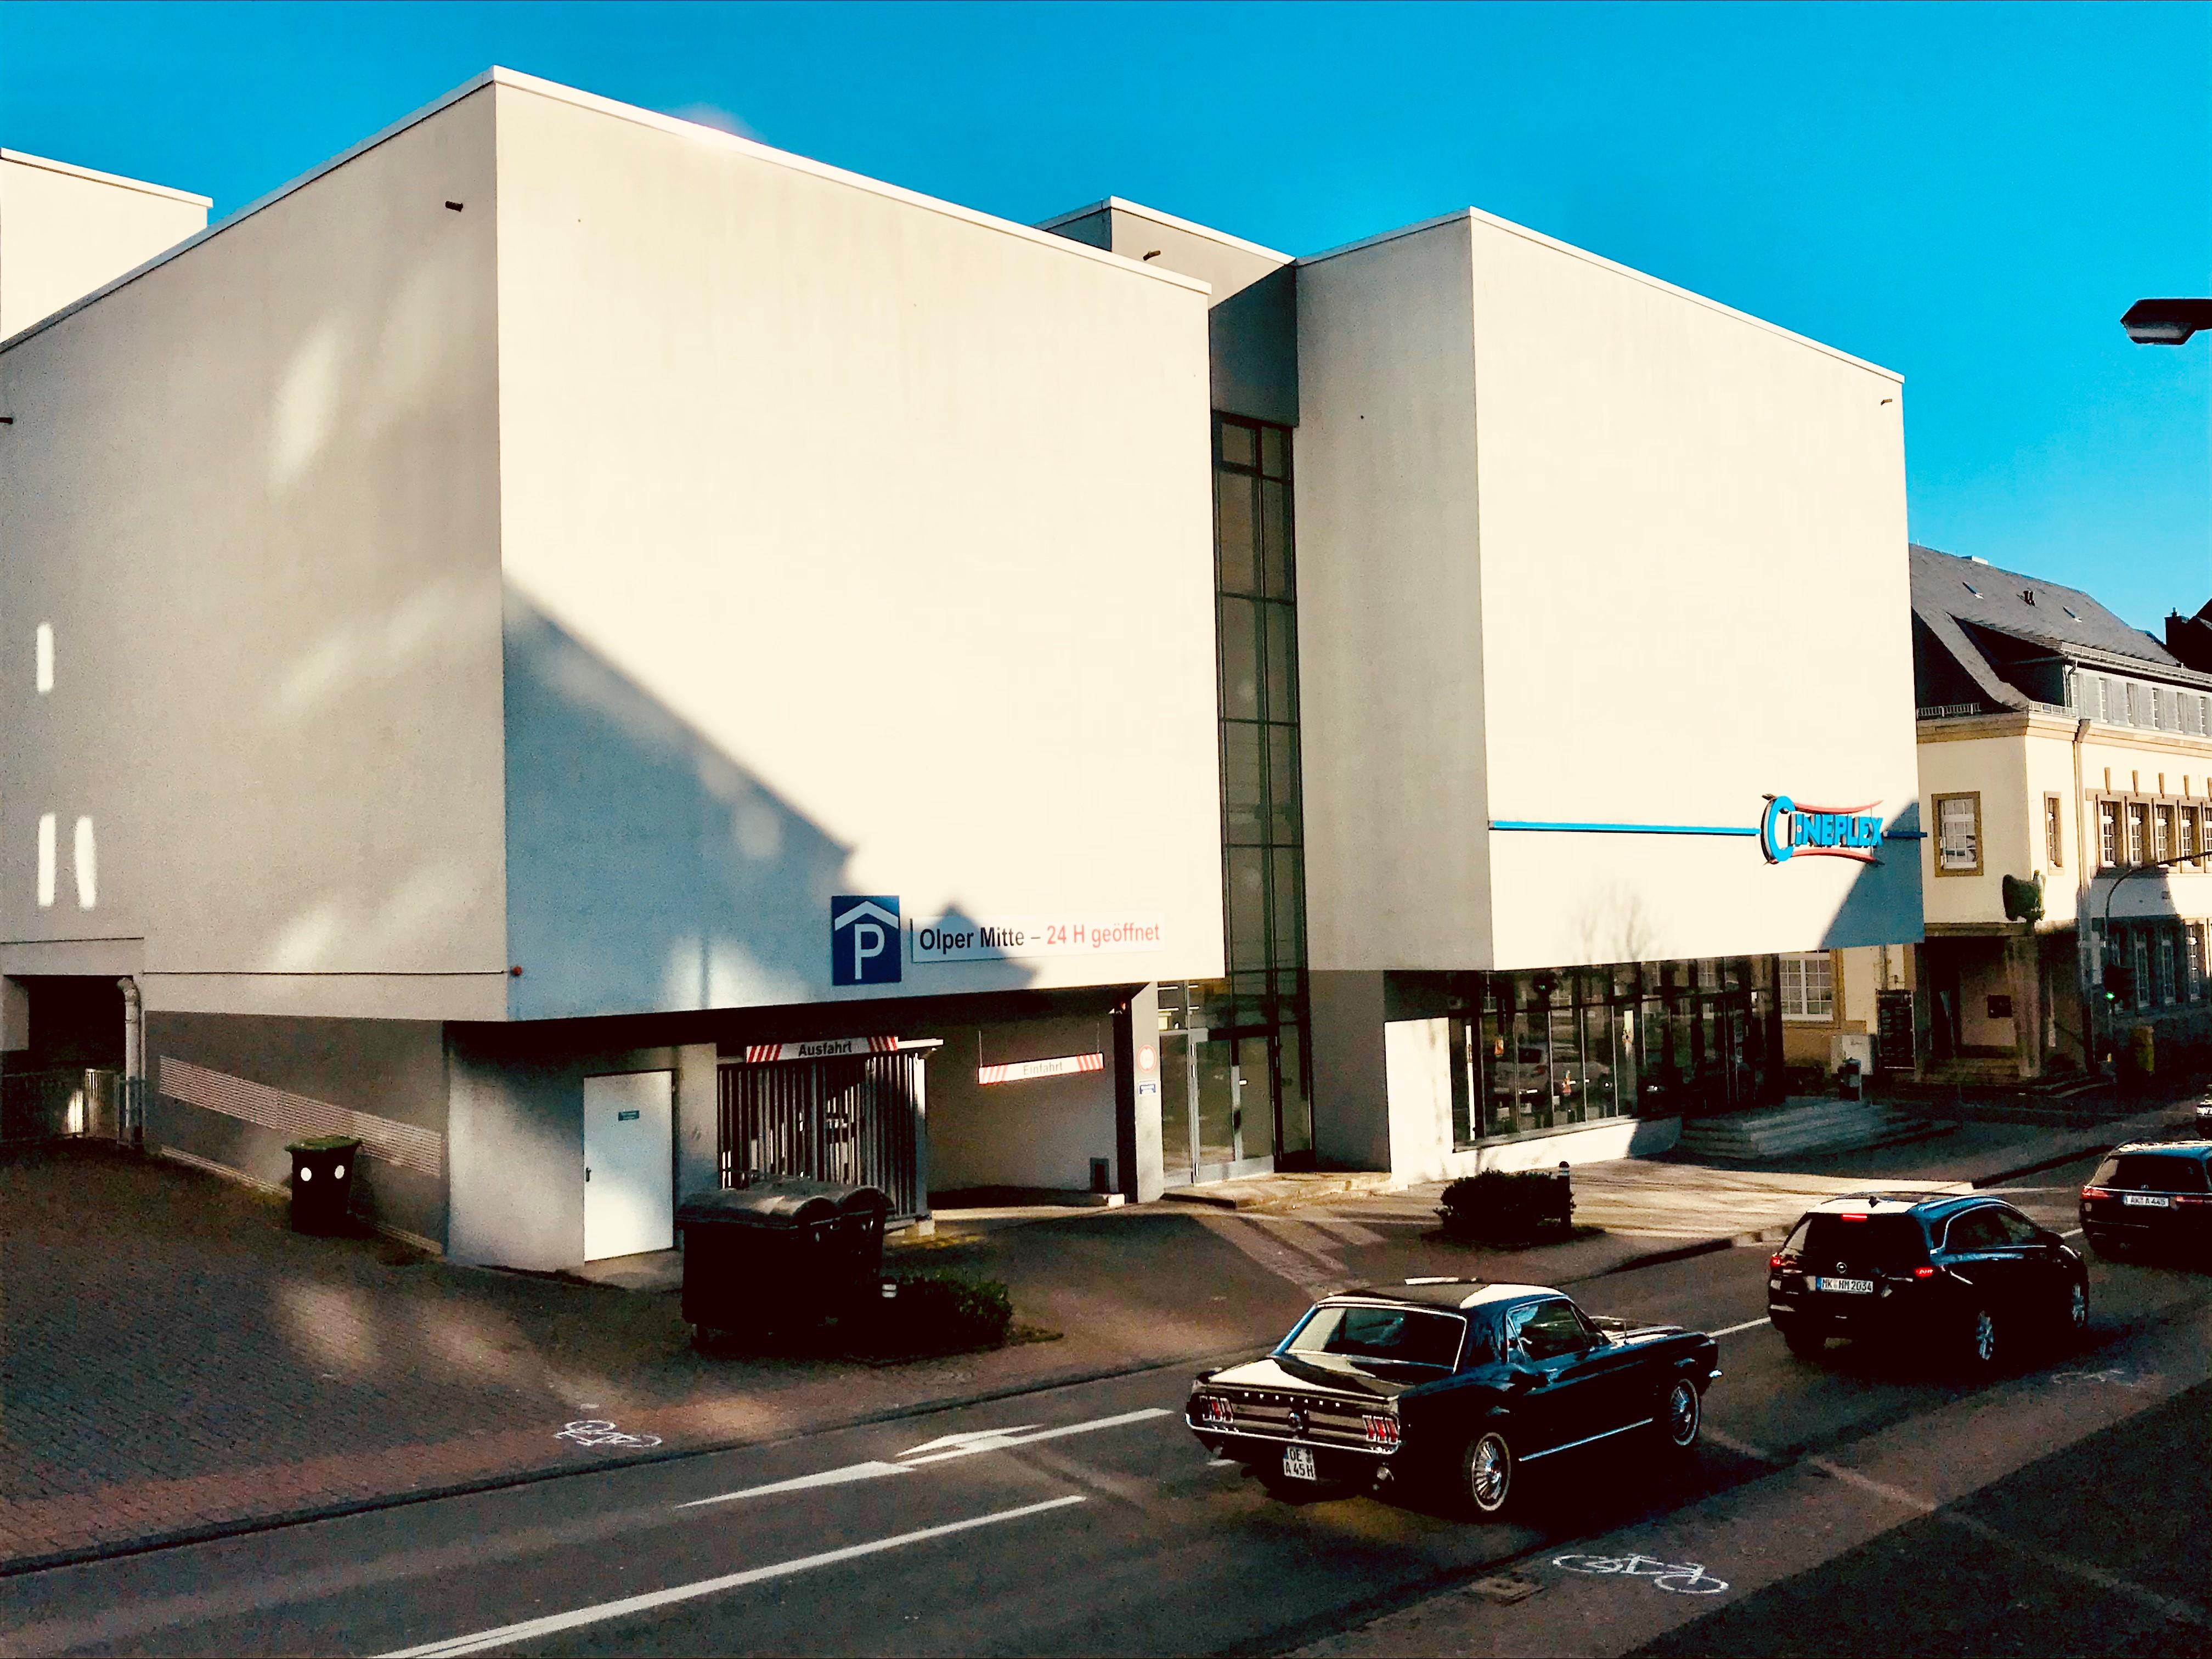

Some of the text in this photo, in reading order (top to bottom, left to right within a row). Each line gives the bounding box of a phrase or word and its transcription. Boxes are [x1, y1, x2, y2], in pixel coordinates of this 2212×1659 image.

[1760, 795, 1884, 862] CINEPLEX
[920, 928, 974, 955] Olper
[980, 927, 1024, 947] Mitte
[1047, 925, 1067, 944] 24
[1073, 924, 1085, 943] H
[1091, 922, 1160, 948] geöffnet
[854, 923, 885, 980] P
[798, 1041, 852, 1057] Ausfahrt
[1023, 1061, 1063, 1075] Einfahrt
[1851, 1280, 1872, 1291] 2034
